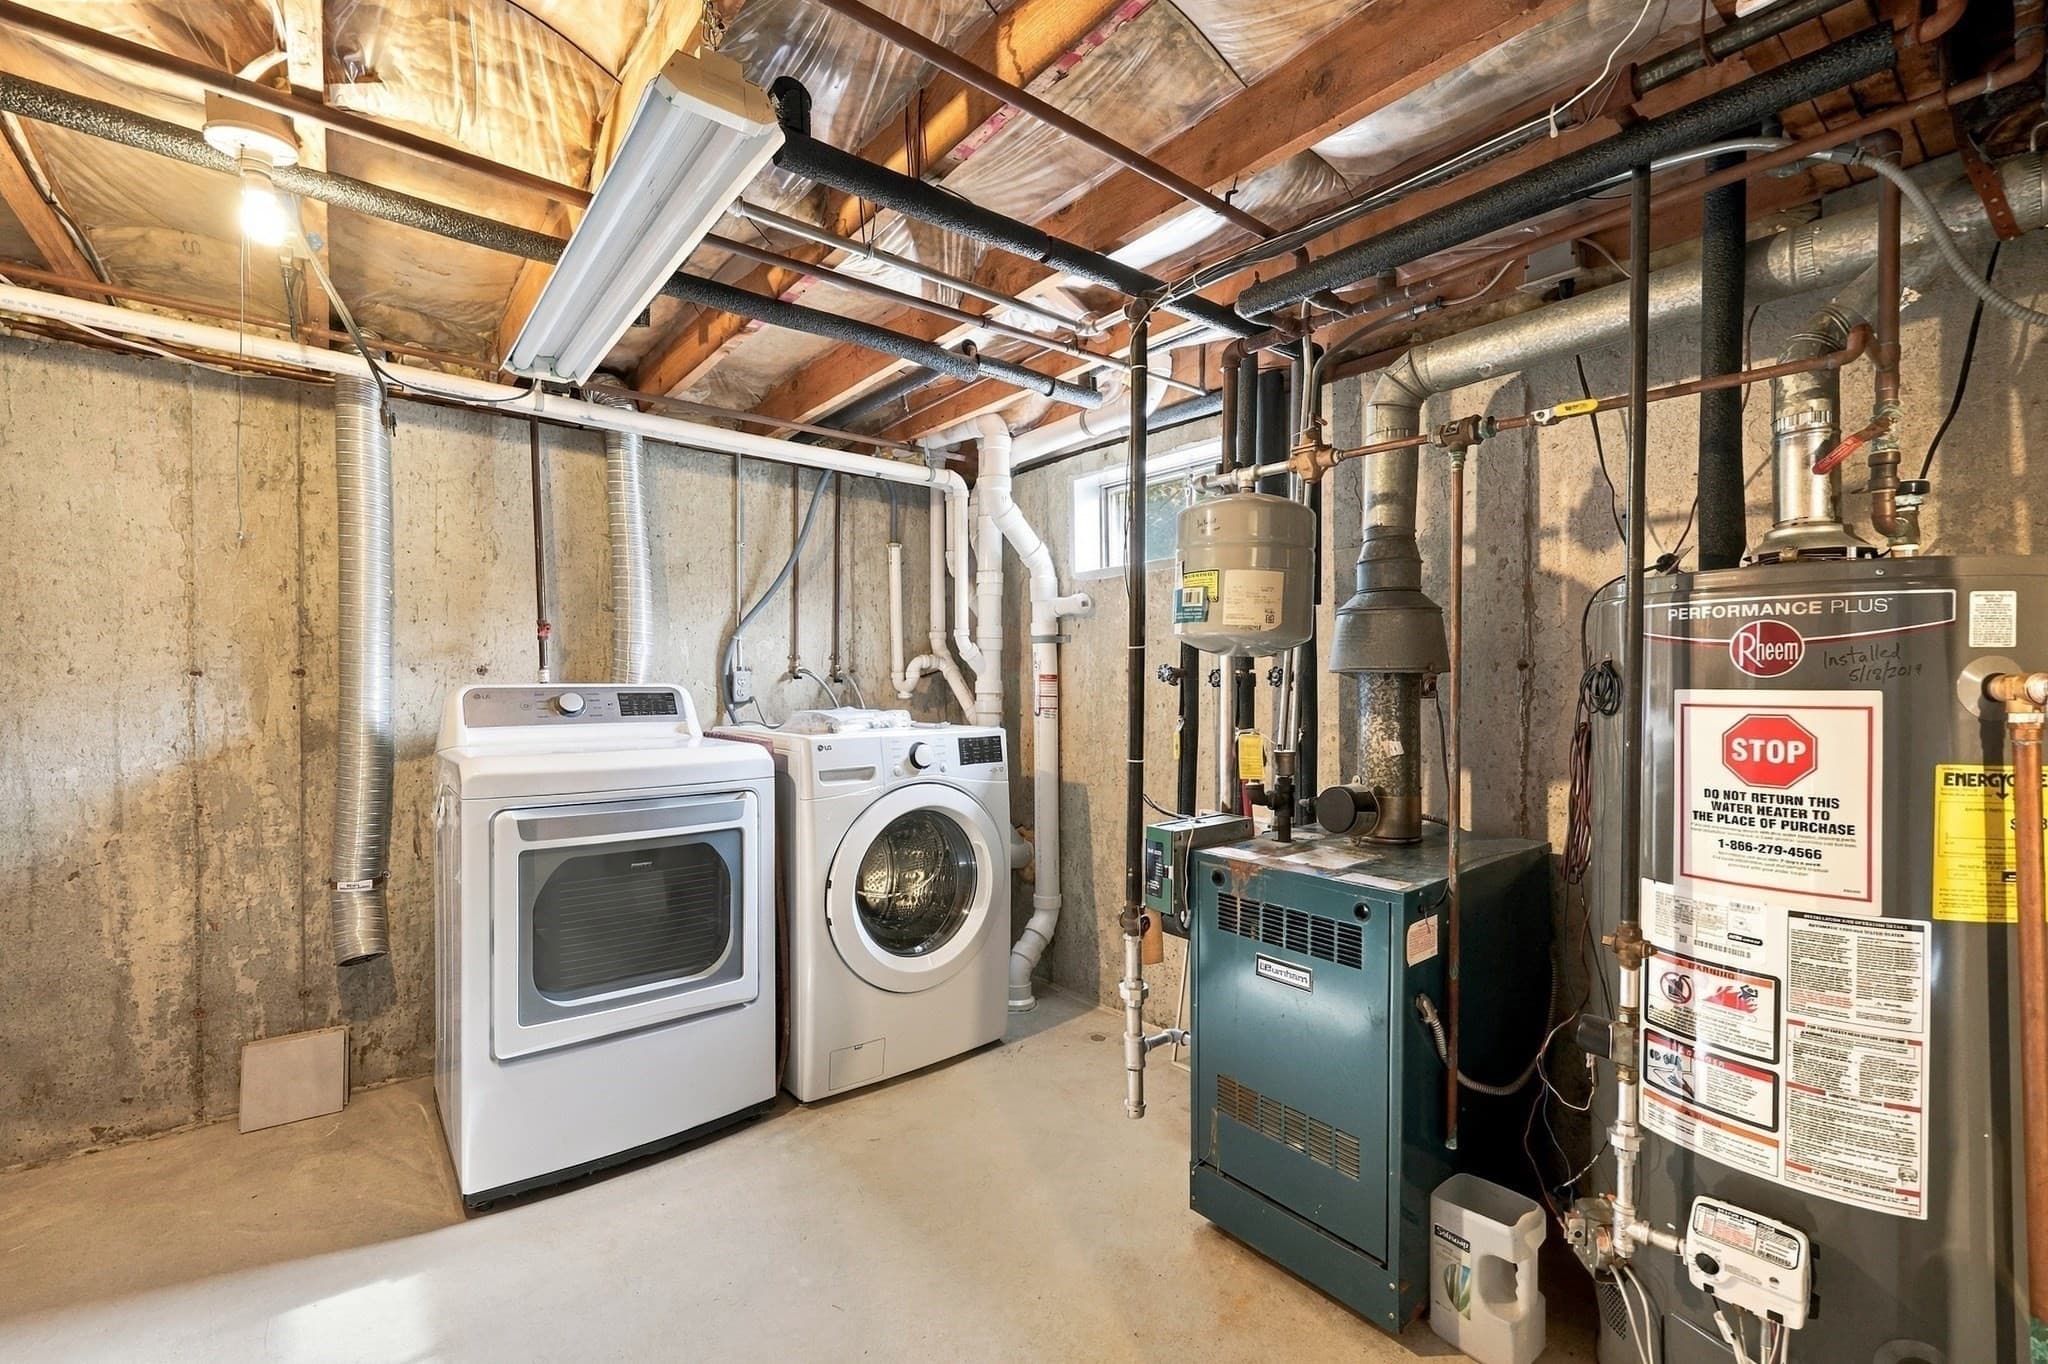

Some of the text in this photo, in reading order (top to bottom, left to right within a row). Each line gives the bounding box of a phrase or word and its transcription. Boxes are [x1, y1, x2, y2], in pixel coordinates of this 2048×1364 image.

[1668, 601, 1823, 622] PERFORMANCE
[1738, 621, 1800, 669] Rheem
[1823, 642, 1901, 670] Installed
[1731, 738, 1807, 765] STOP
[1704, 788, 1841, 810] DO NOT RETURN THIS
[1711, 801, 1831, 821] WATER HEATER TO
[1692, 810, 1713, 822] THE
[1716, 814, 1756, 828] PLACE
[1759, 818, 1778, 829] OF
[1781, 820, 1856, 836] PURCHASE
[1718, 838, 1823, 860] 1-866-279-4566
